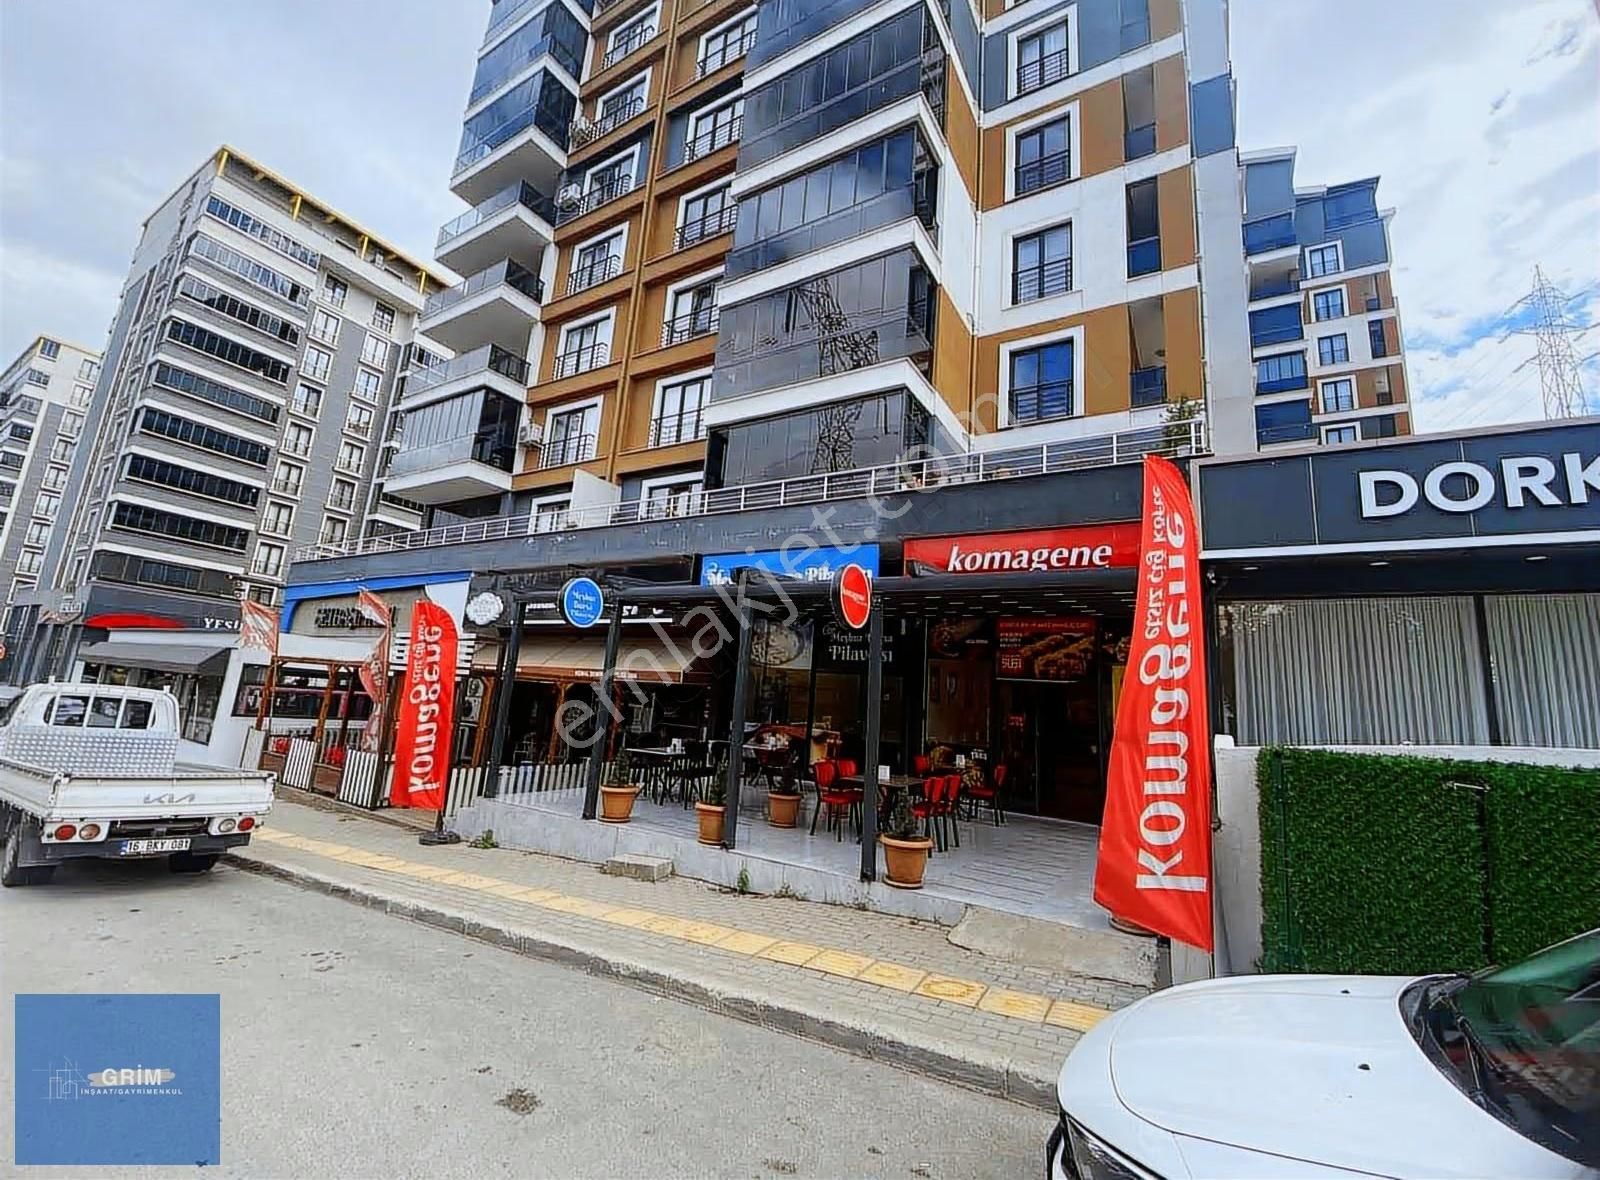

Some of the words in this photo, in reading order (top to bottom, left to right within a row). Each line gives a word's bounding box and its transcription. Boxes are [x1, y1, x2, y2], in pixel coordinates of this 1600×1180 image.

[1358, 452, 1600, 519] DORK
[948, 544, 1113, 572] komagene
[128, 841, 141, 851] 16
